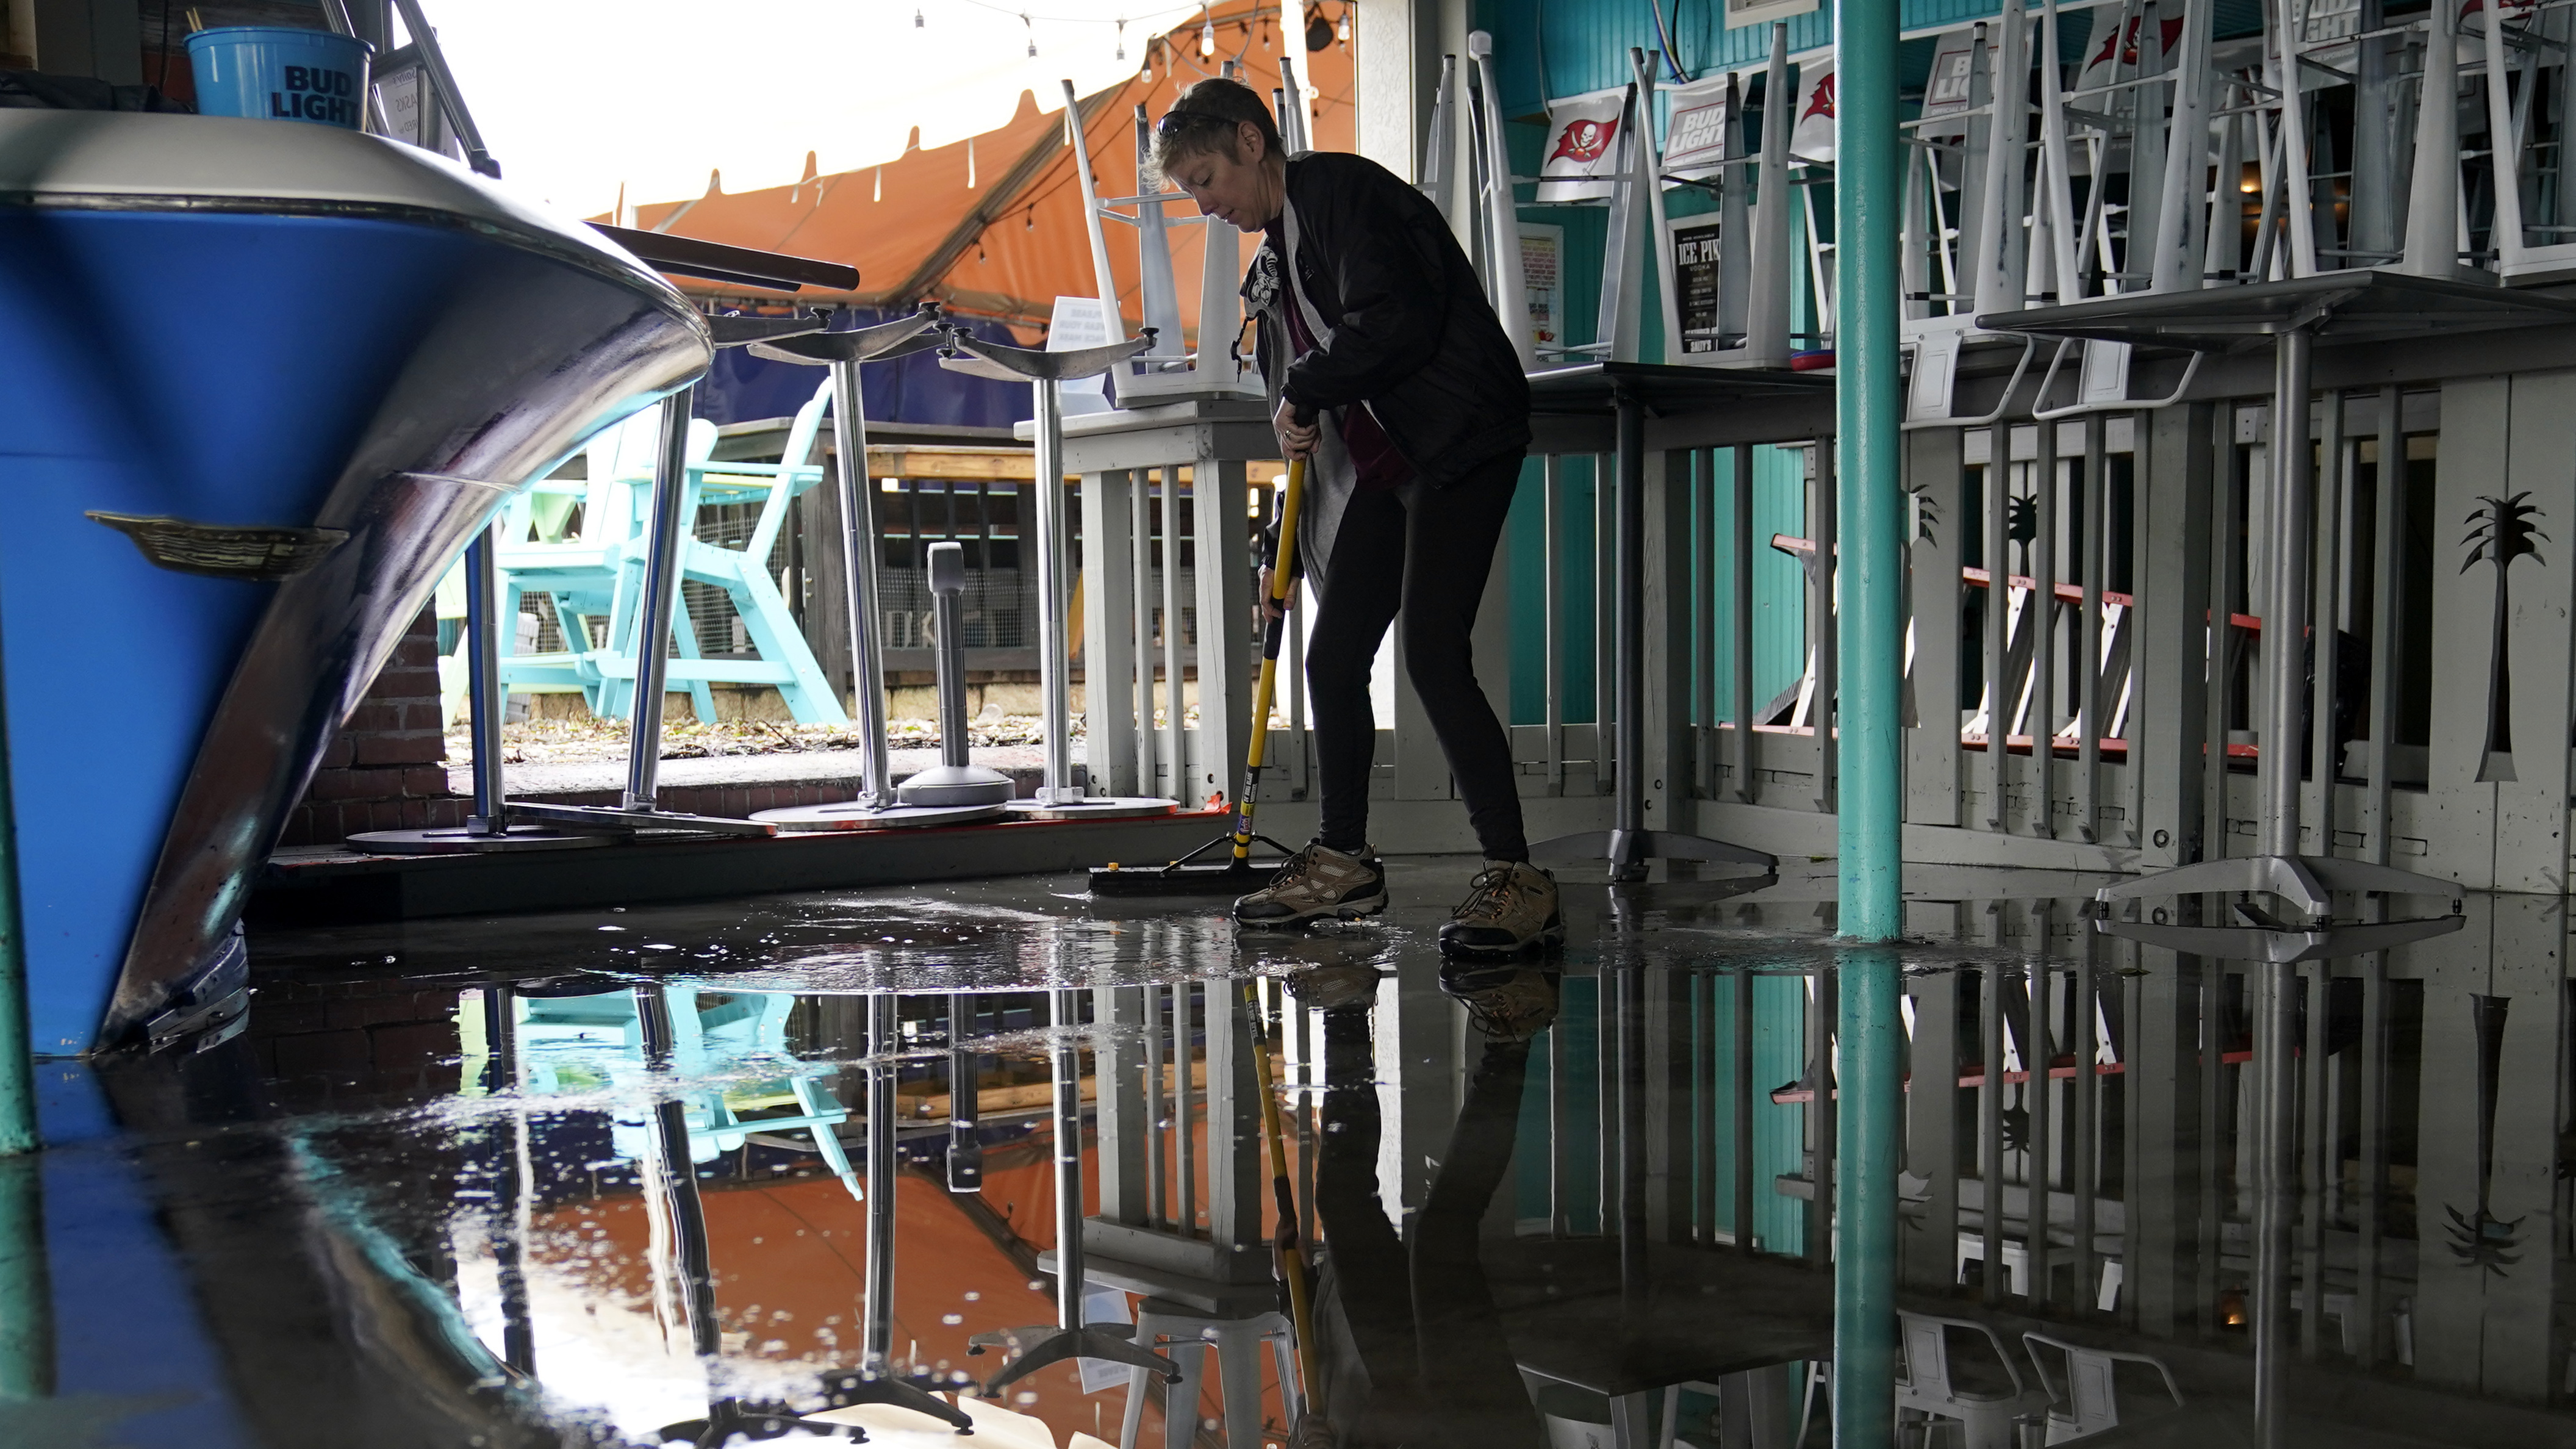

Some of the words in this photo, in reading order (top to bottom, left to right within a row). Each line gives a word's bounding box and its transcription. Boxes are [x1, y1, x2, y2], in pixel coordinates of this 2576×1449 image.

[285, 65, 352, 97] BUD
[271, 92, 359, 128] LIGHT
[1682, 107, 1724, 133] BUD
[1669, 123, 1723, 154] LIGHT
[1677, 242, 1697, 265] ICE
[1700, 239, 1720, 262] PIK
